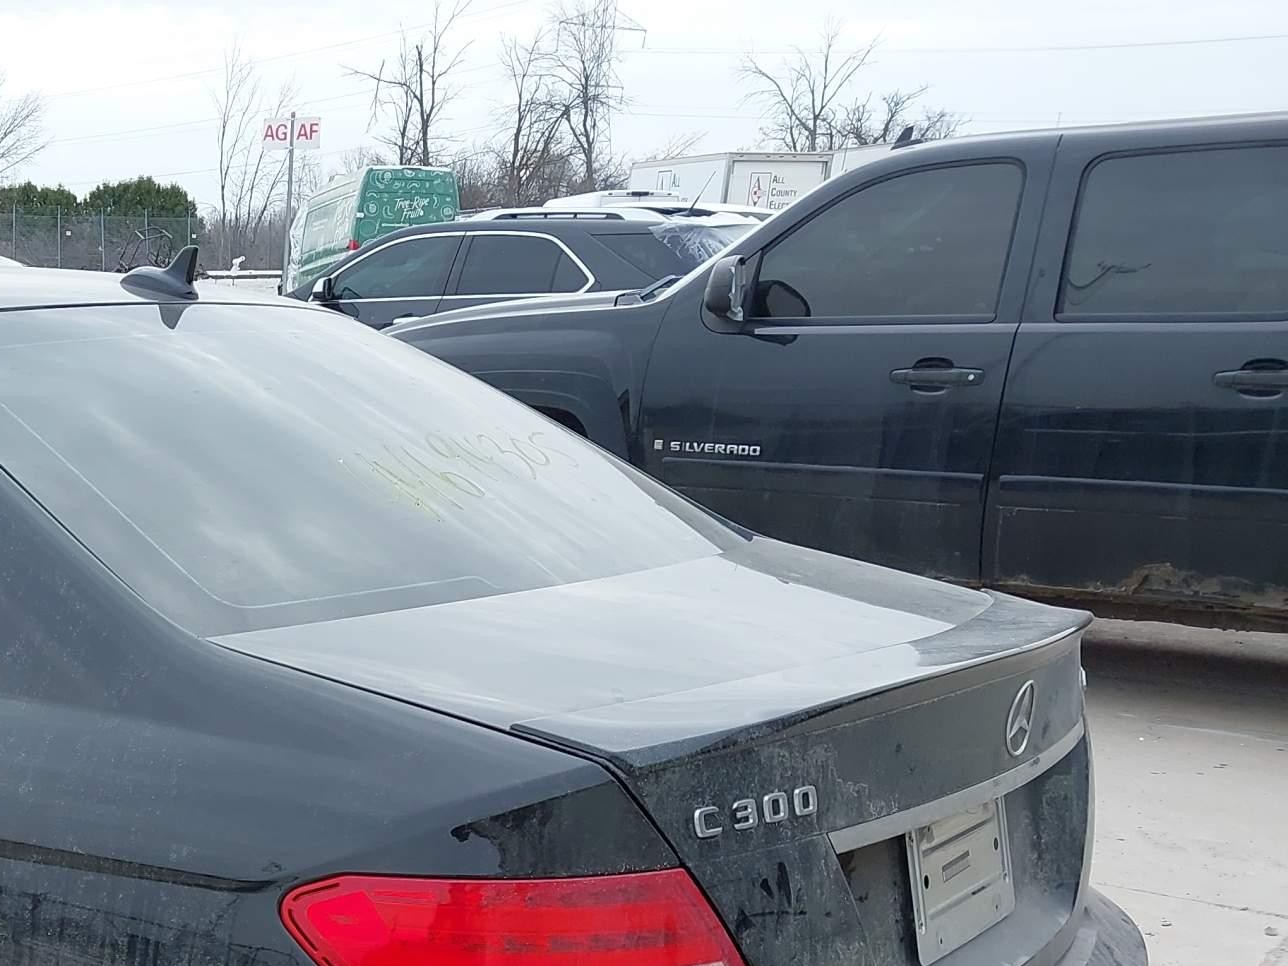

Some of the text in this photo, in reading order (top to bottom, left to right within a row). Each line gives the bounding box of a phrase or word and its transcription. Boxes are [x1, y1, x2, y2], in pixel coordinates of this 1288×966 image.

[263, 123, 288, 141] AG
[296, 122, 319, 140] AF
[670, 441, 761, 456] SILVERADO
[694, 785, 818, 838] C 300
